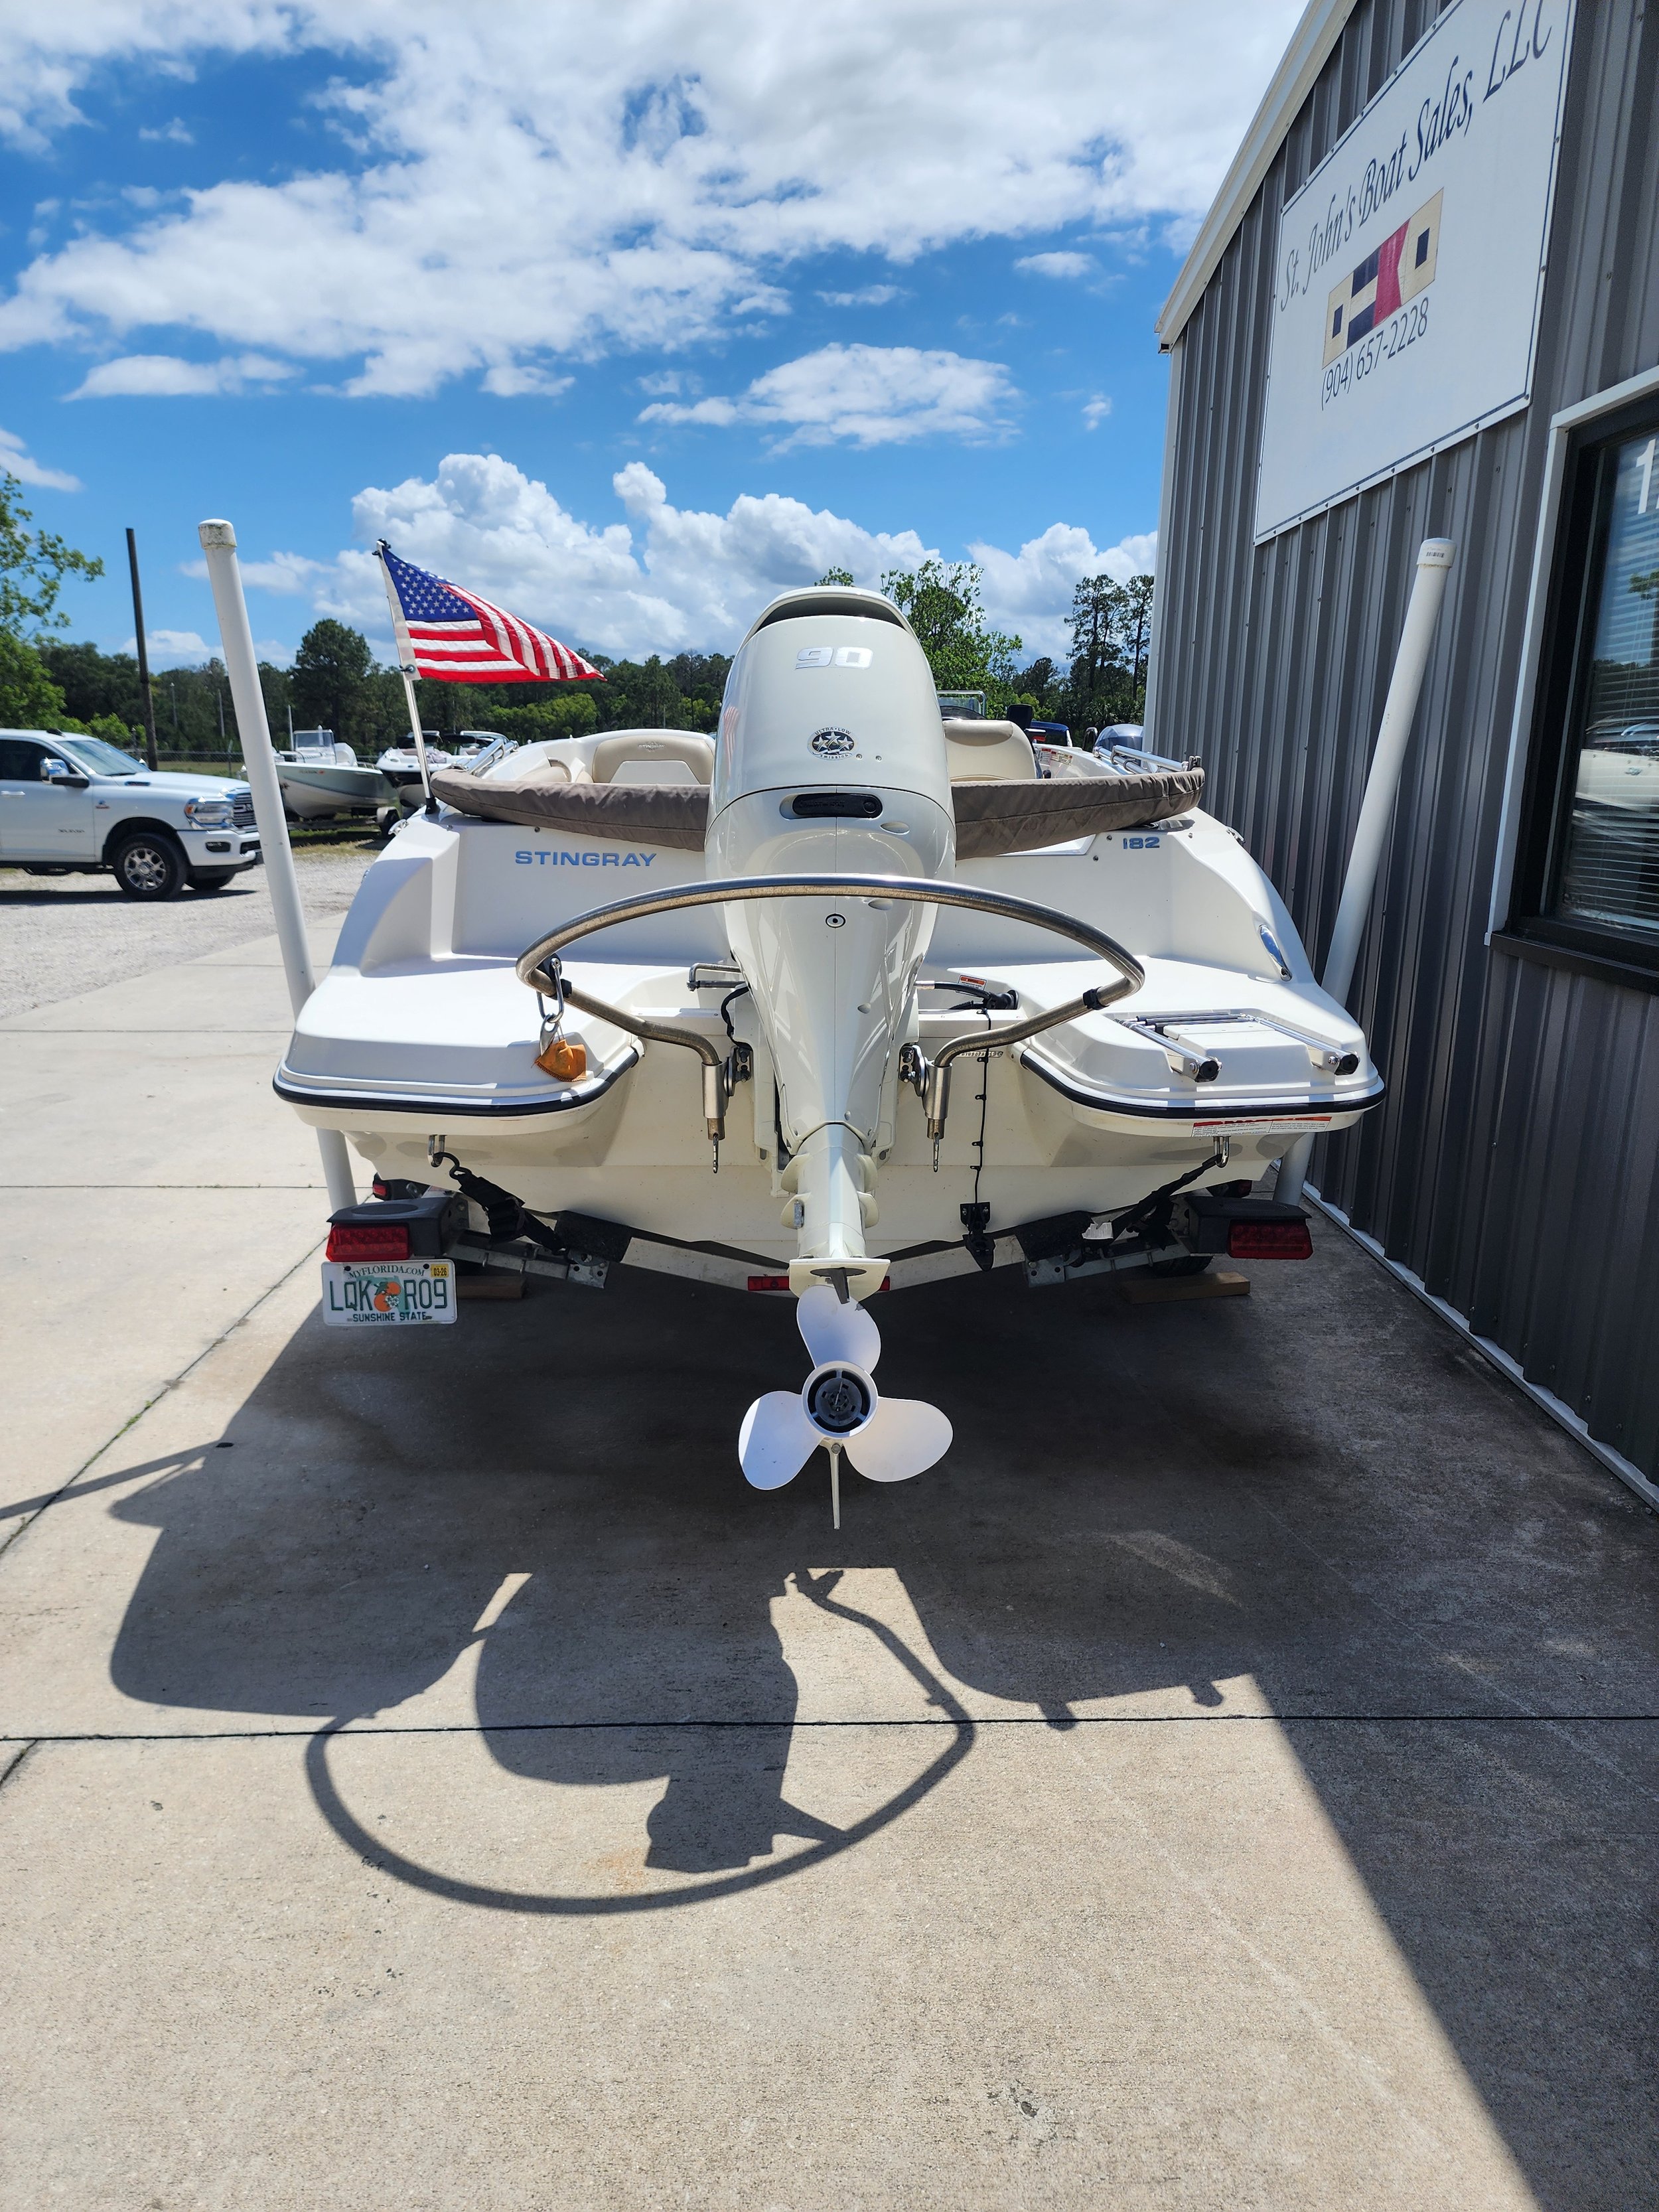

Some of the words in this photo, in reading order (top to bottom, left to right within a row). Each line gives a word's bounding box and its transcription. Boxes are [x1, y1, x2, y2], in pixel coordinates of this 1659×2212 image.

[1281, 248, 1299, 312] St.
[1302, 184, 1356, 295] John's
[1358, 129, 1407, 228] Boat
[1408, 54, 1473, 182] Sales,
[1482, 0, 1553, 104] LLC
[1321, 351, 1353, 411] (904)
[1356, 297, 1429, 380] 657-2228
[796, 646, 874, 670] 90
[1123, 836, 1161, 849] 182
[515, 850, 657, 867] STINGRAY
[348, 1264, 425, 1278] MYFLORIDA.COM
[433, 1267, 447, 1276] 03-26
[330, 1280, 373, 1311] LQK
[352, 1312, 396, 1323] SUNSHINE
[399, 1311, 426, 1321] STATE
